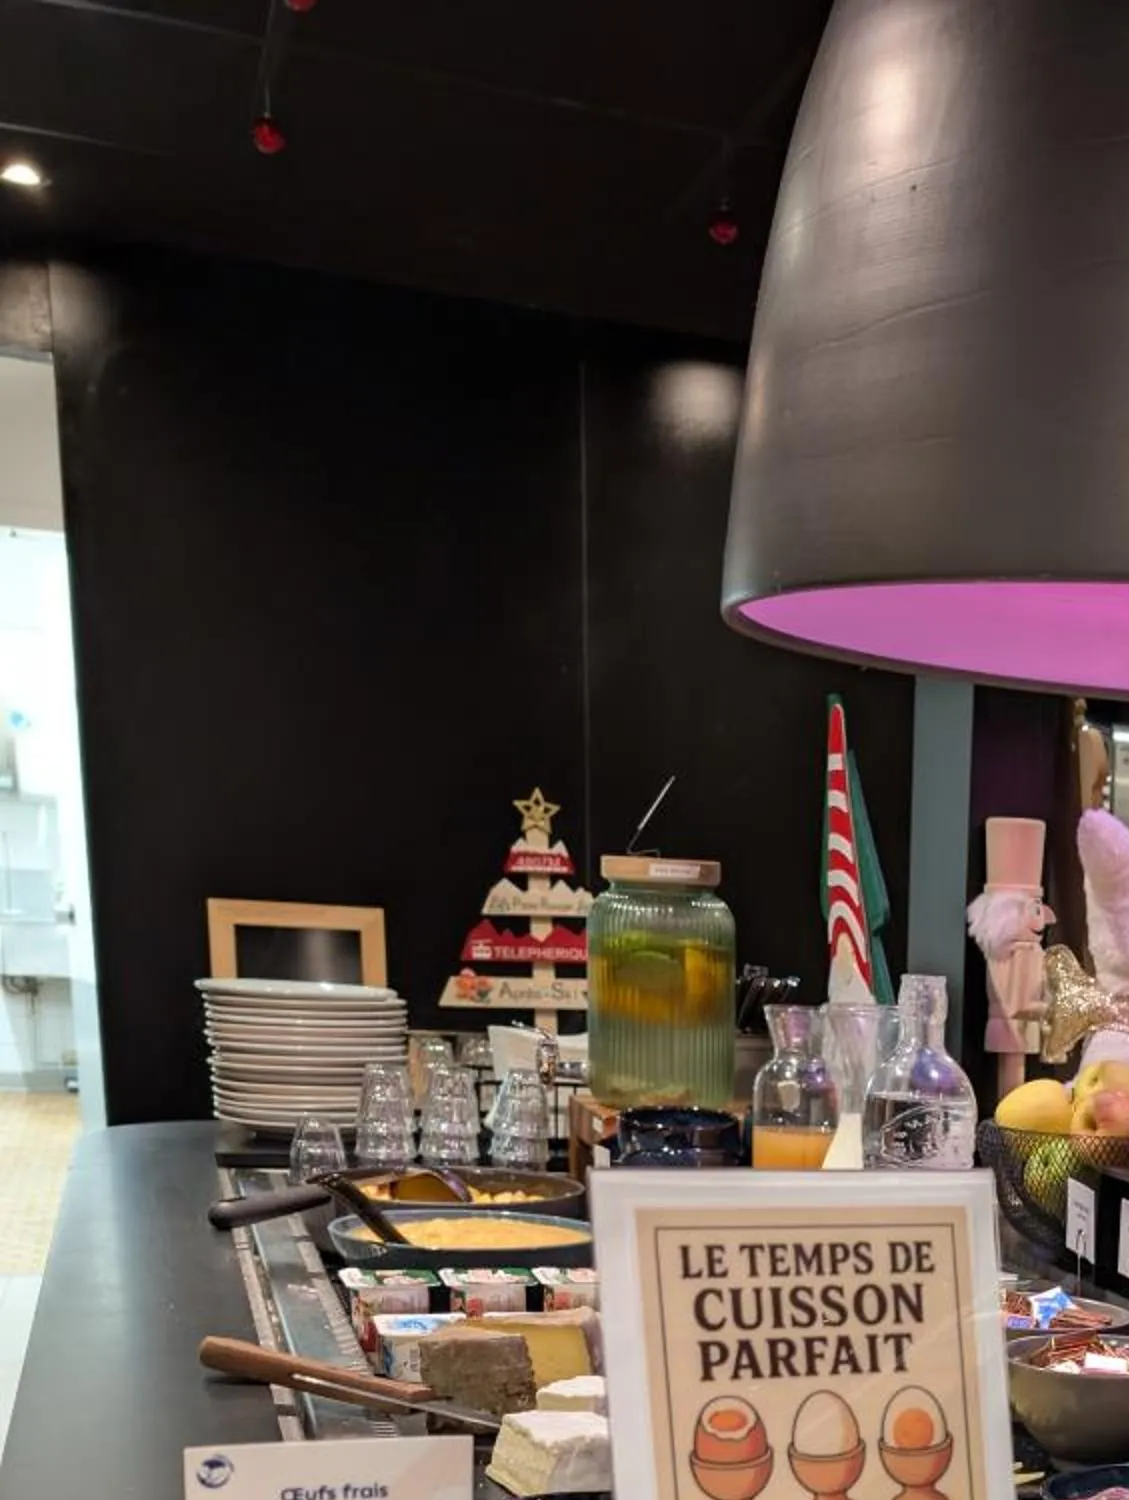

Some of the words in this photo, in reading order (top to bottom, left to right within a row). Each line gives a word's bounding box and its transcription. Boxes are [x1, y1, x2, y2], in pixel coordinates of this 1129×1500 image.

[680, 1244, 729, 1279] LE
[739, 1241, 874, 1278] TEMPS
[889, 1241, 935, 1275] DE
[693, 1283, 924, 1331] CUISSON
[697, 1333, 912, 1382] PARFAIT
[342, 1481, 388, 1500] frais
